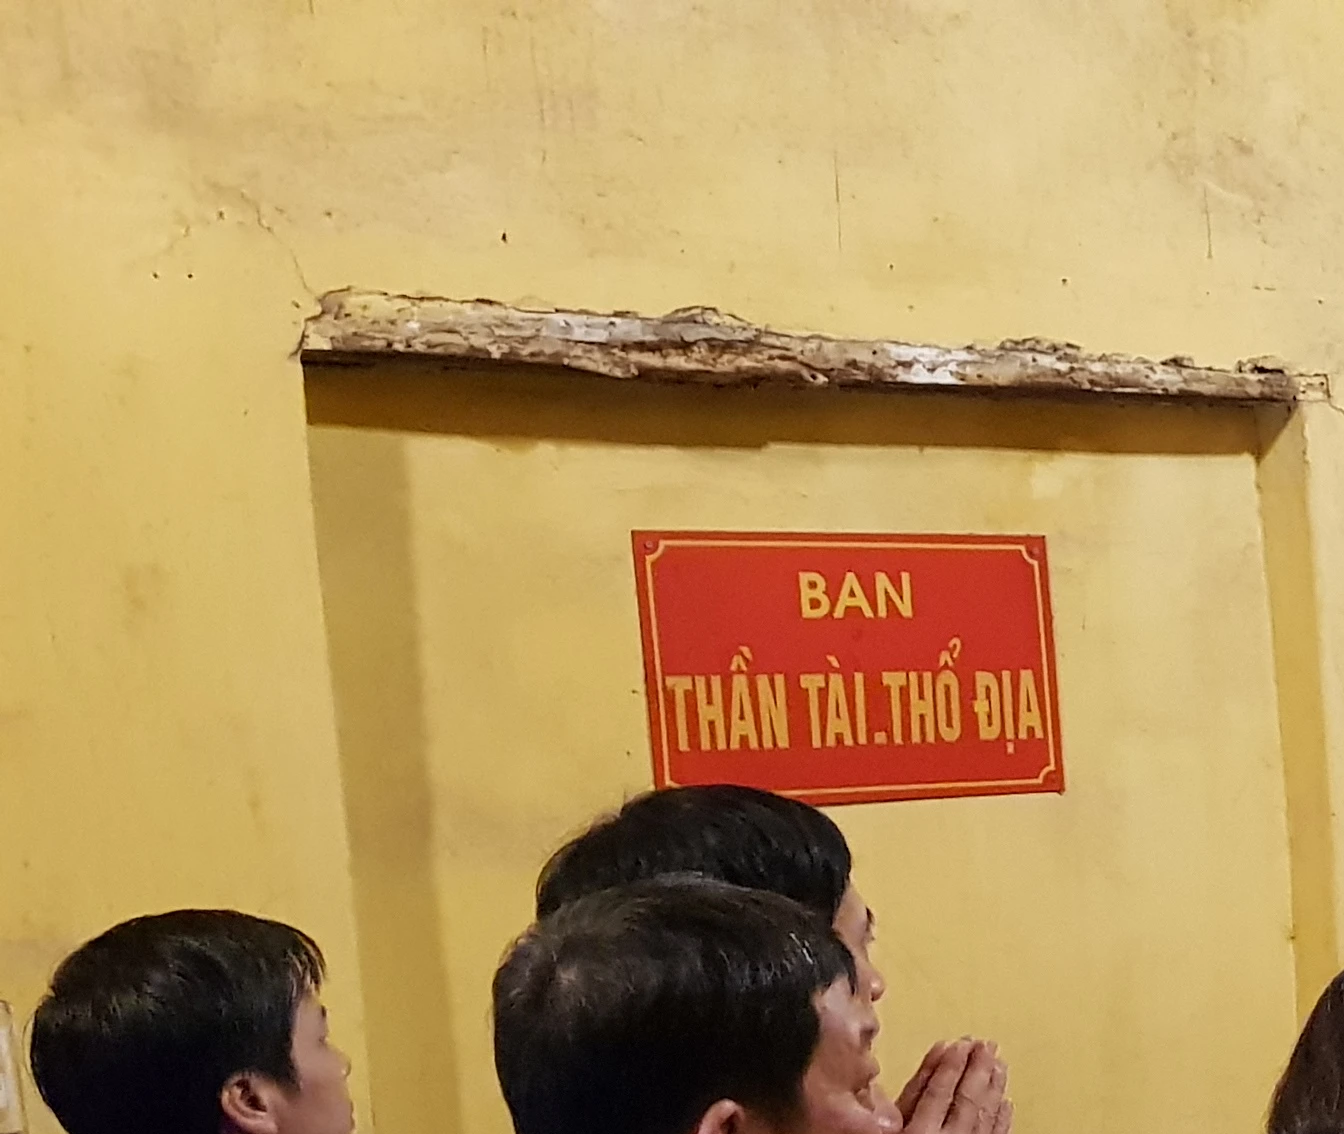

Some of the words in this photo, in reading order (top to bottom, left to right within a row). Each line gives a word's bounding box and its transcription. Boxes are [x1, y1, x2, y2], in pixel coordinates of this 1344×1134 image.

[798, 571, 913, 619] BAN
[665, 645, 790, 752] THẦN
[974, 668, 1044, 754] ĐỊA
